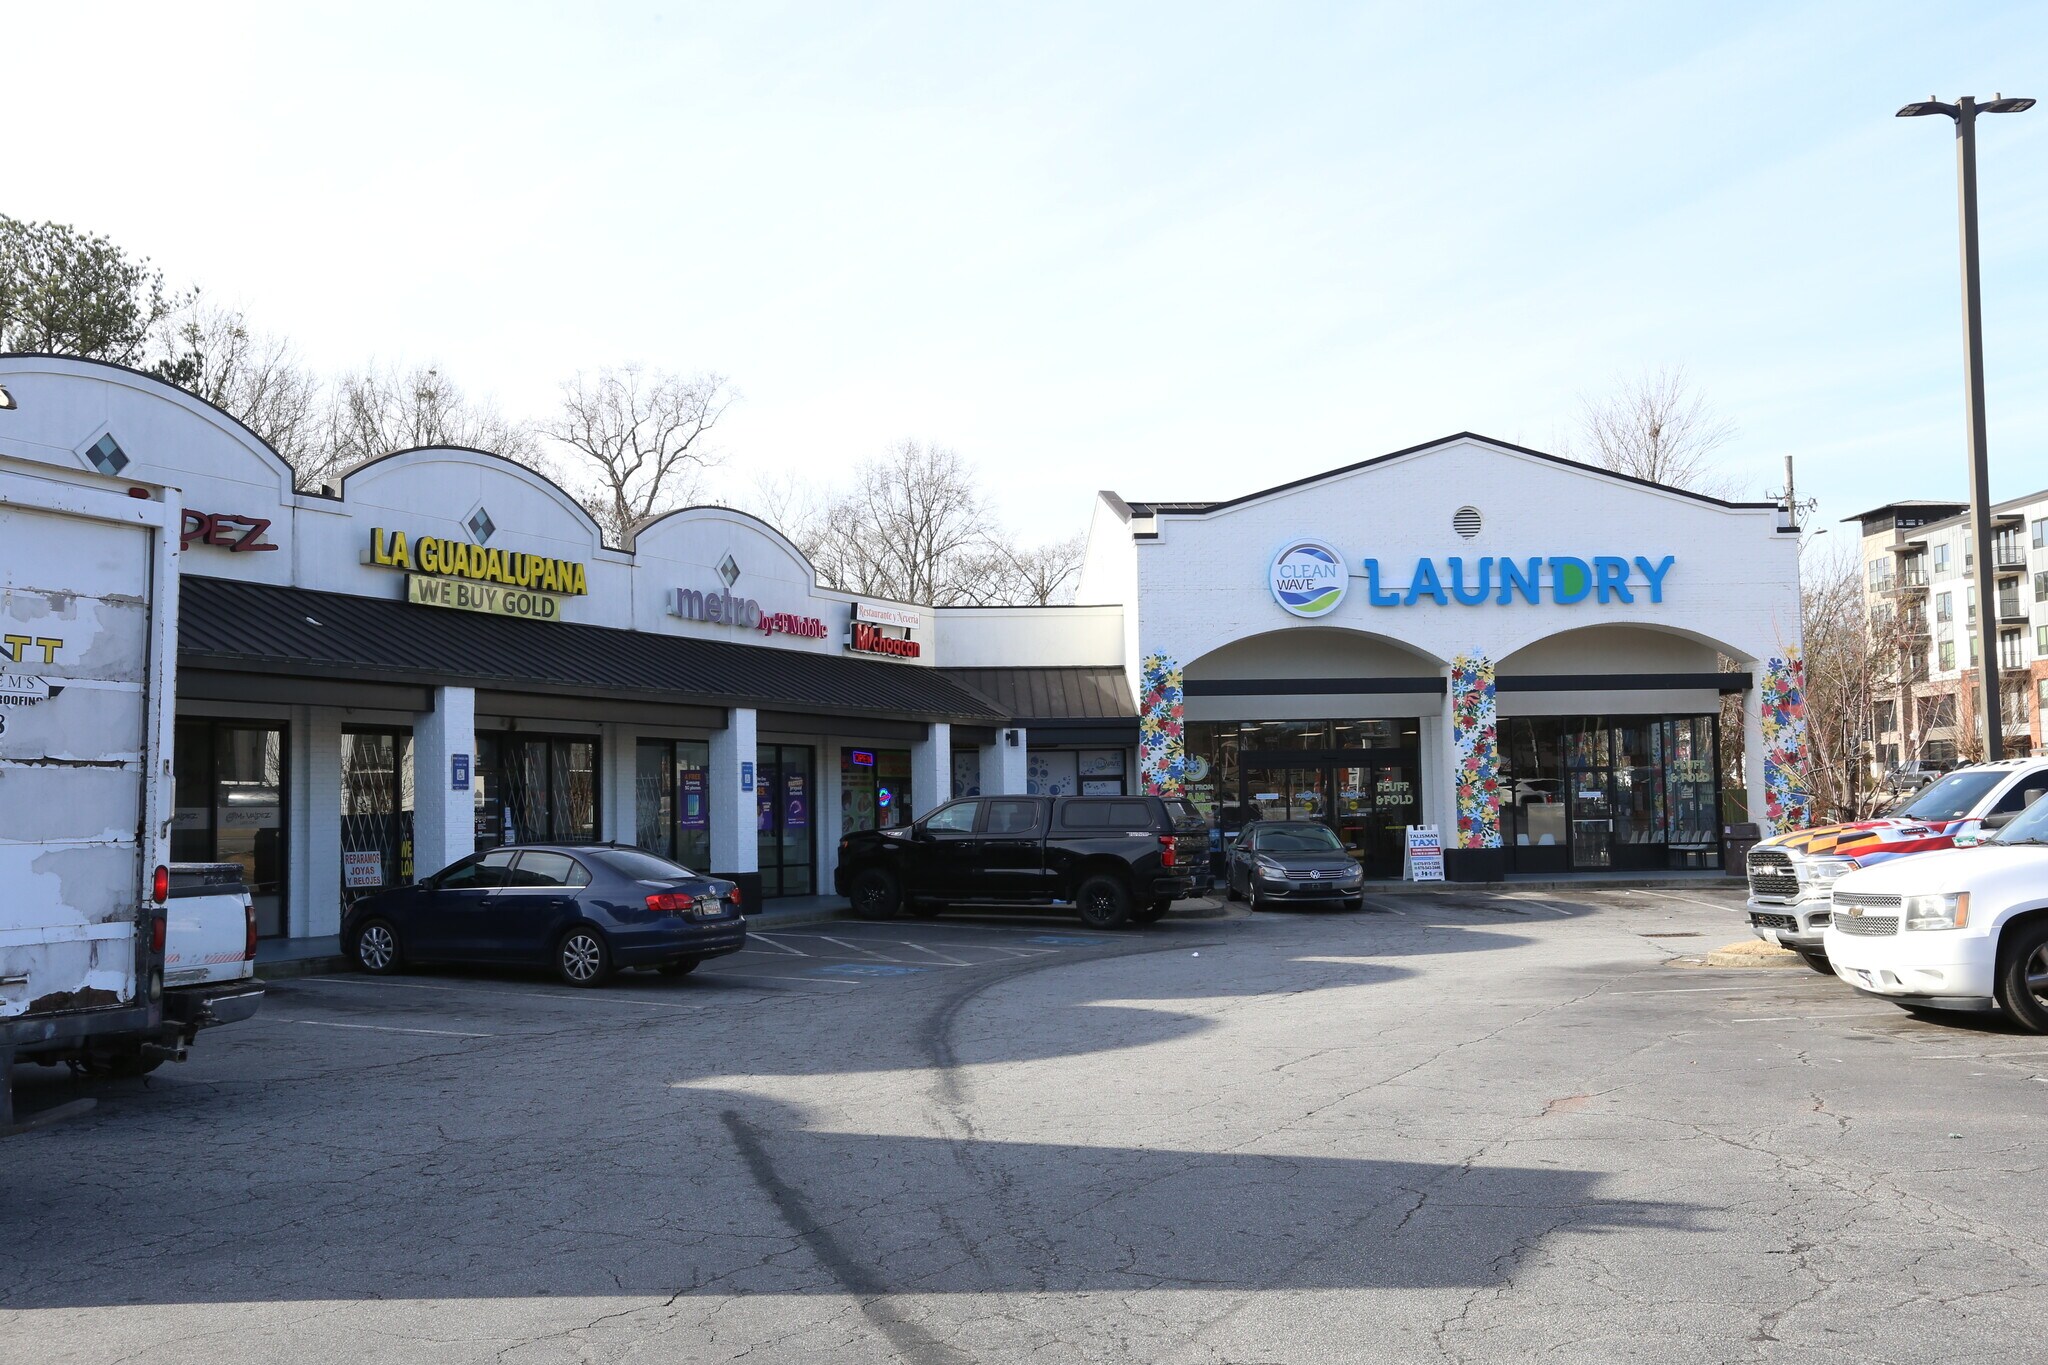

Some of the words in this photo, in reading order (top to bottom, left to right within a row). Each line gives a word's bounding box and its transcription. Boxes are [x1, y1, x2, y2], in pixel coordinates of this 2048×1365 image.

[370, 527, 410, 568] LA
[414, 535, 588, 595] GUADALUPANA
[1280, 564, 1336, 578] CLEAN
[1276, 578, 1314, 590] WAVE
[1364, 556, 1675, 606] LAUNDRY
[418, 579, 450, 605] WE
[457, 584, 498, 611] BUY
[502, 592, 555, 618] GOLD
[671, 587, 760, 628] metro
[858, 603, 893, 620] Restaurante
[855, 753, 872, 764] OPEN
[1376, 781, 1410, 792] FLUFF
[401, 841, 412, 858] WE
[345, 853, 380, 864] REPARAMOS
[350, 866, 375, 876] JOYAS
[353, 876, 381, 885] RELOJES
